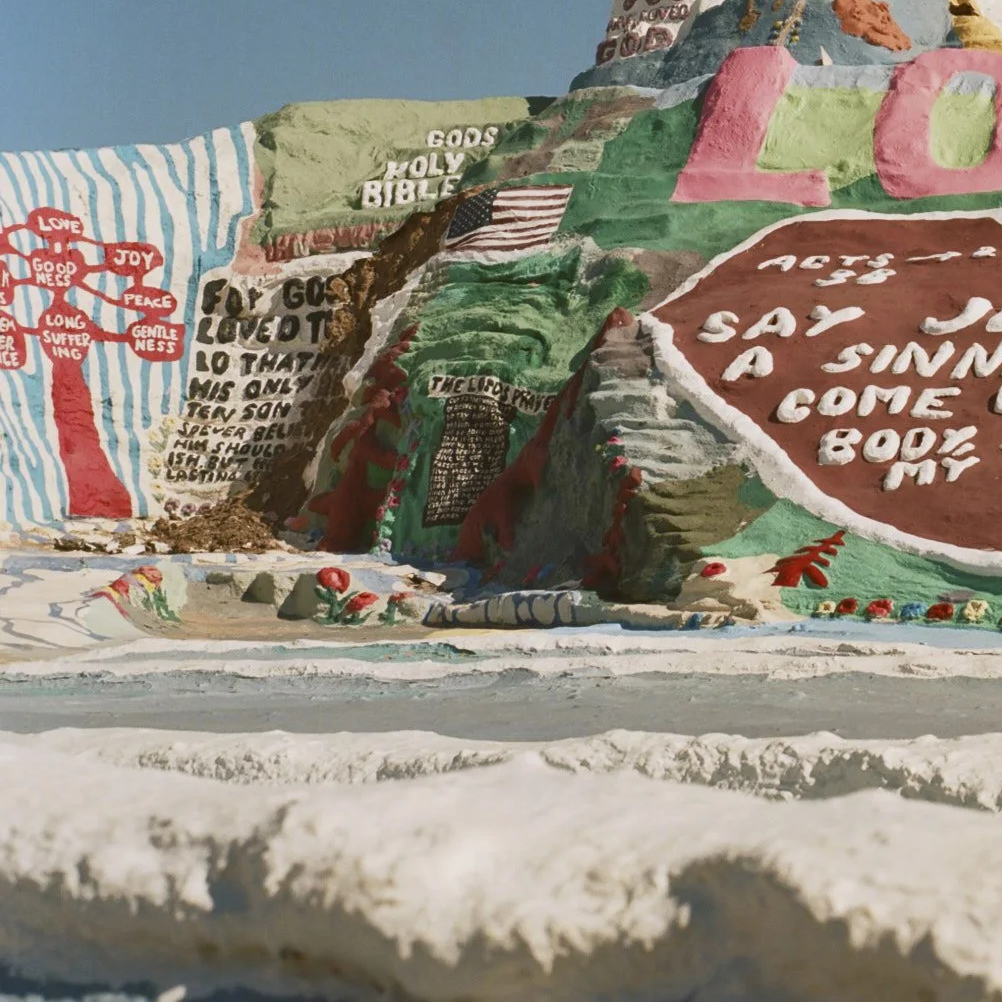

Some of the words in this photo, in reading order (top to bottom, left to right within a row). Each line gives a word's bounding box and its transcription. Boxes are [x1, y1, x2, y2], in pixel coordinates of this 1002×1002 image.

[427, 127, 498, 148] GODS
[384, 152, 464, 180] HOLY
[362, 174, 461, 209] BIBLE
[38, 215, 81, 234] LOVE
[32, 257, 77, 276] GOOD
[113, 249, 154, 270] JOY
[757, 253, 895, 271] ACTS
[124, 293, 172, 309] PEACE
[45, 314, 86, 331] LONG
[697, 307, 866, 343] SAY
[43, 331, 91, 348] SUFFER
[131, 324, 179, 341] GENTLE
[52, 346, 82, 361] ING
[135, 338, 176, 354] NESS
[240, 351, 314, 376] THAT
[721, 346, 774, 381] A
[244, 377, 314, 399] ONLY
[432, 376, 466, 393] THE
[242, 402, 292, 420] SON
[777, 384, 961, 423] COME
[206, 456, 248, 470] BUT
[883, 455, 980, 491] MY
